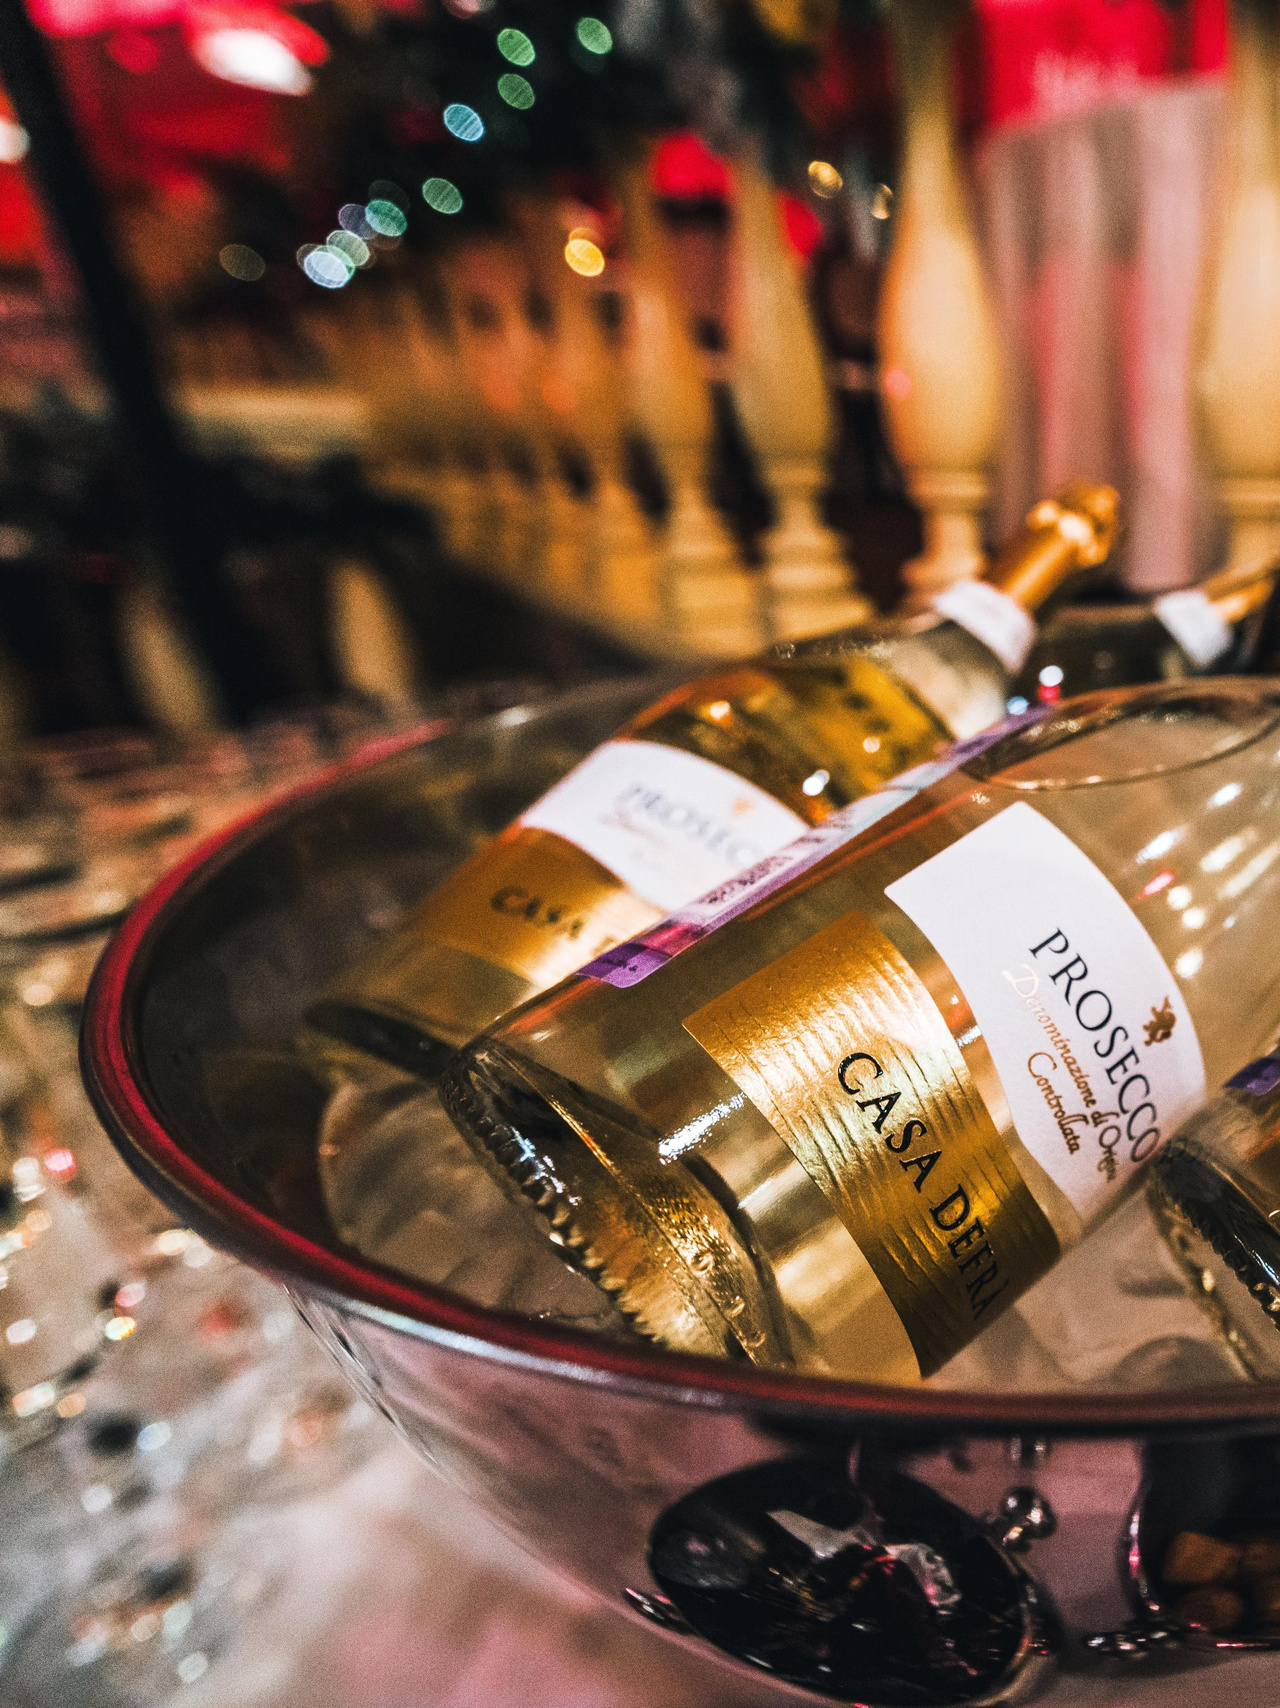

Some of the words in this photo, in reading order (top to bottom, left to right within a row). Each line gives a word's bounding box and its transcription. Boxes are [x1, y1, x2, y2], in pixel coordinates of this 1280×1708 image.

[1002, 964, 1097, 1108] Denominazione
[1091, 1110, 1120, 1128] di
[1028, 927, 1160, 1163] PROSECCO
[1028, 1052, 1089, 1155] Controllata
[837, 1052, 942, 1193] CASA
